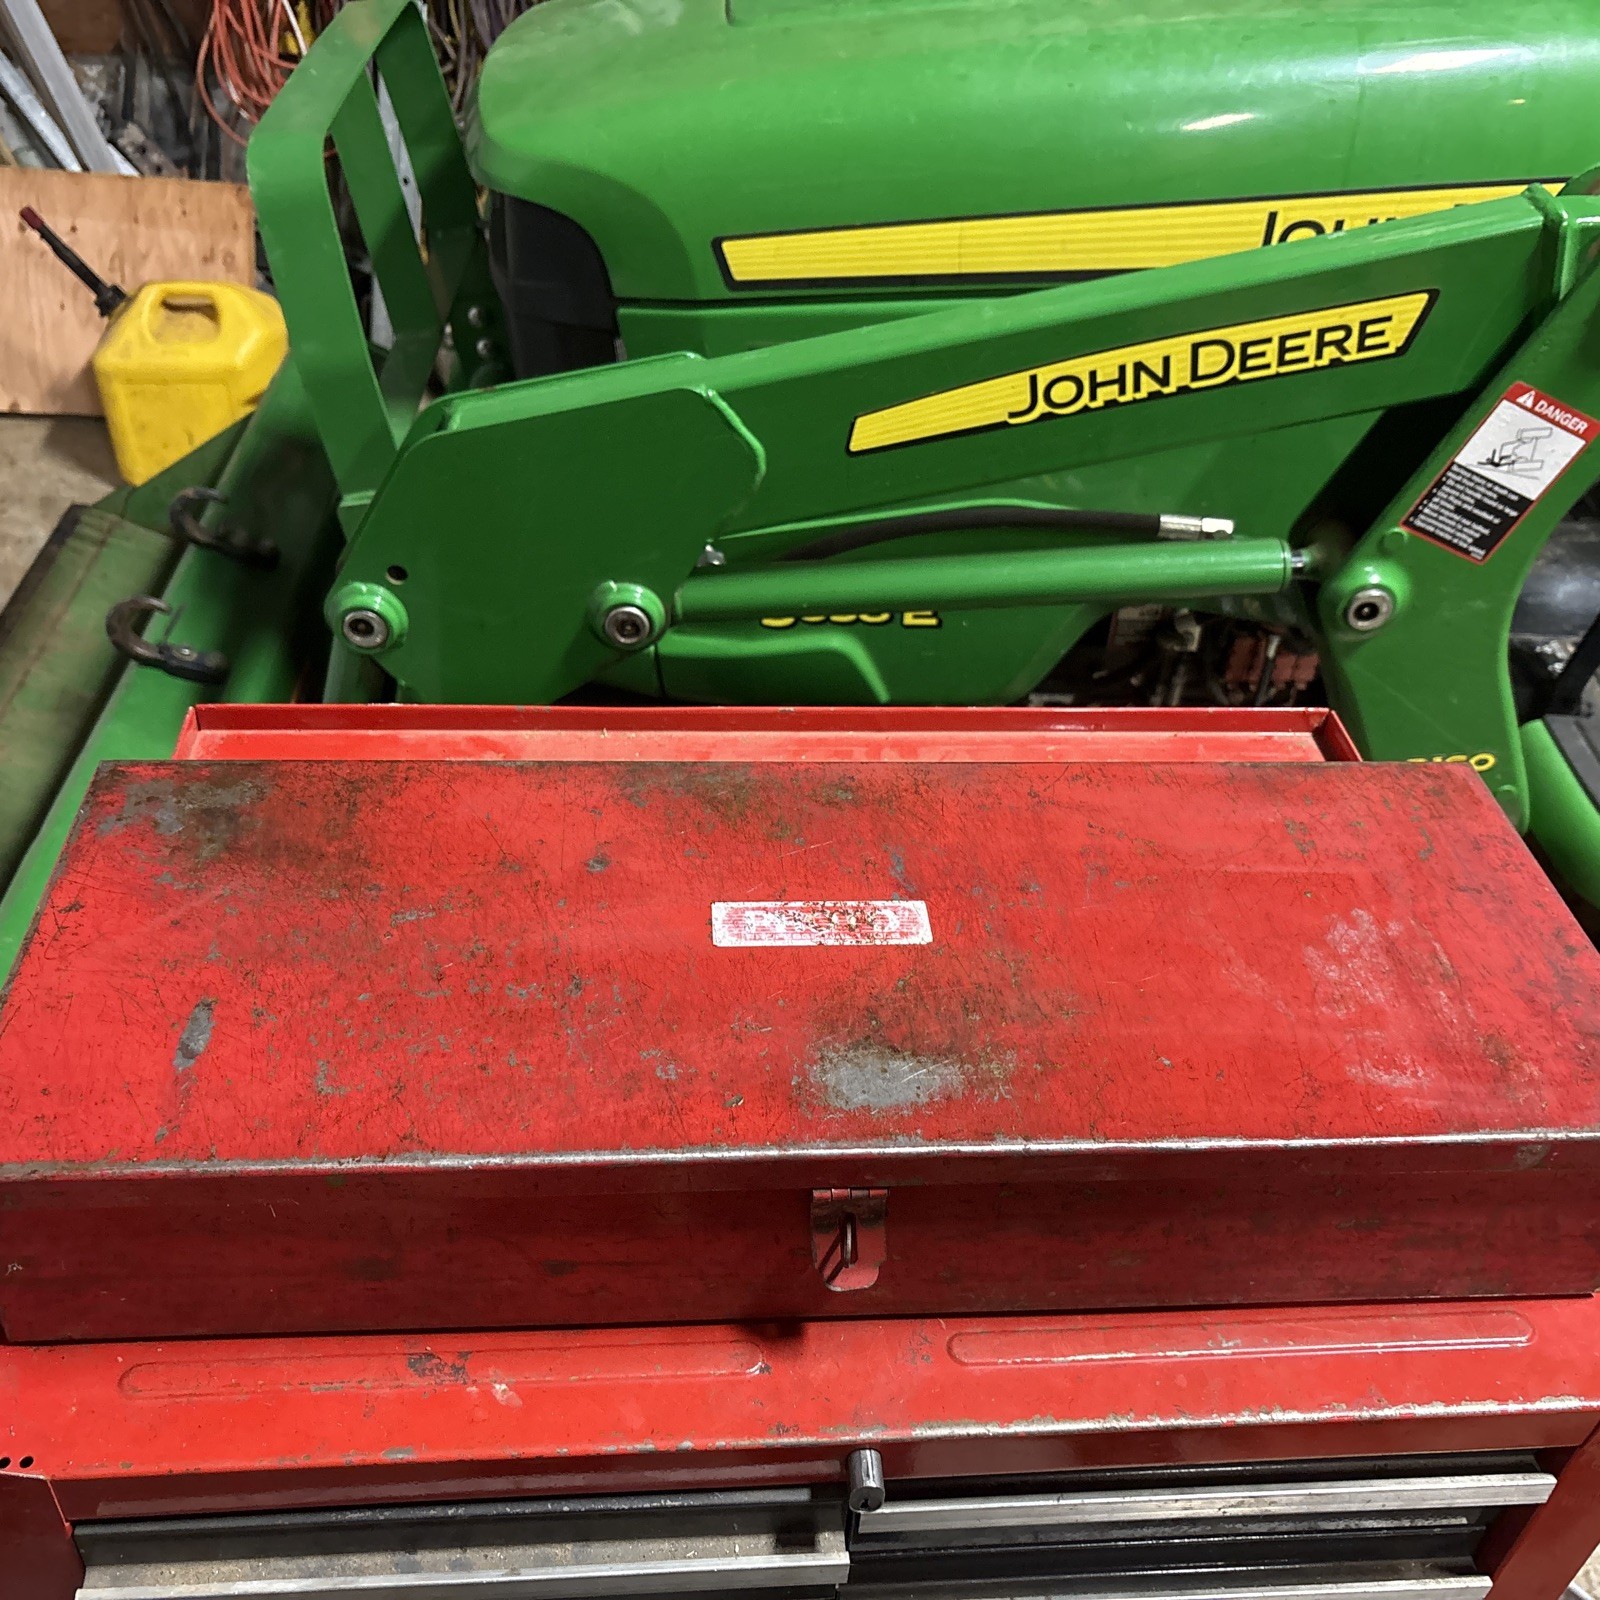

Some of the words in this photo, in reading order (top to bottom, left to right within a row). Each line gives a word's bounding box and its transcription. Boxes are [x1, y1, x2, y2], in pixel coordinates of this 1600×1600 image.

[1008, 355, 1171, 419] JOHN
[1190, 315, 1393, 383] DEERE
[1534, 399, 1588, 434] DANGER
